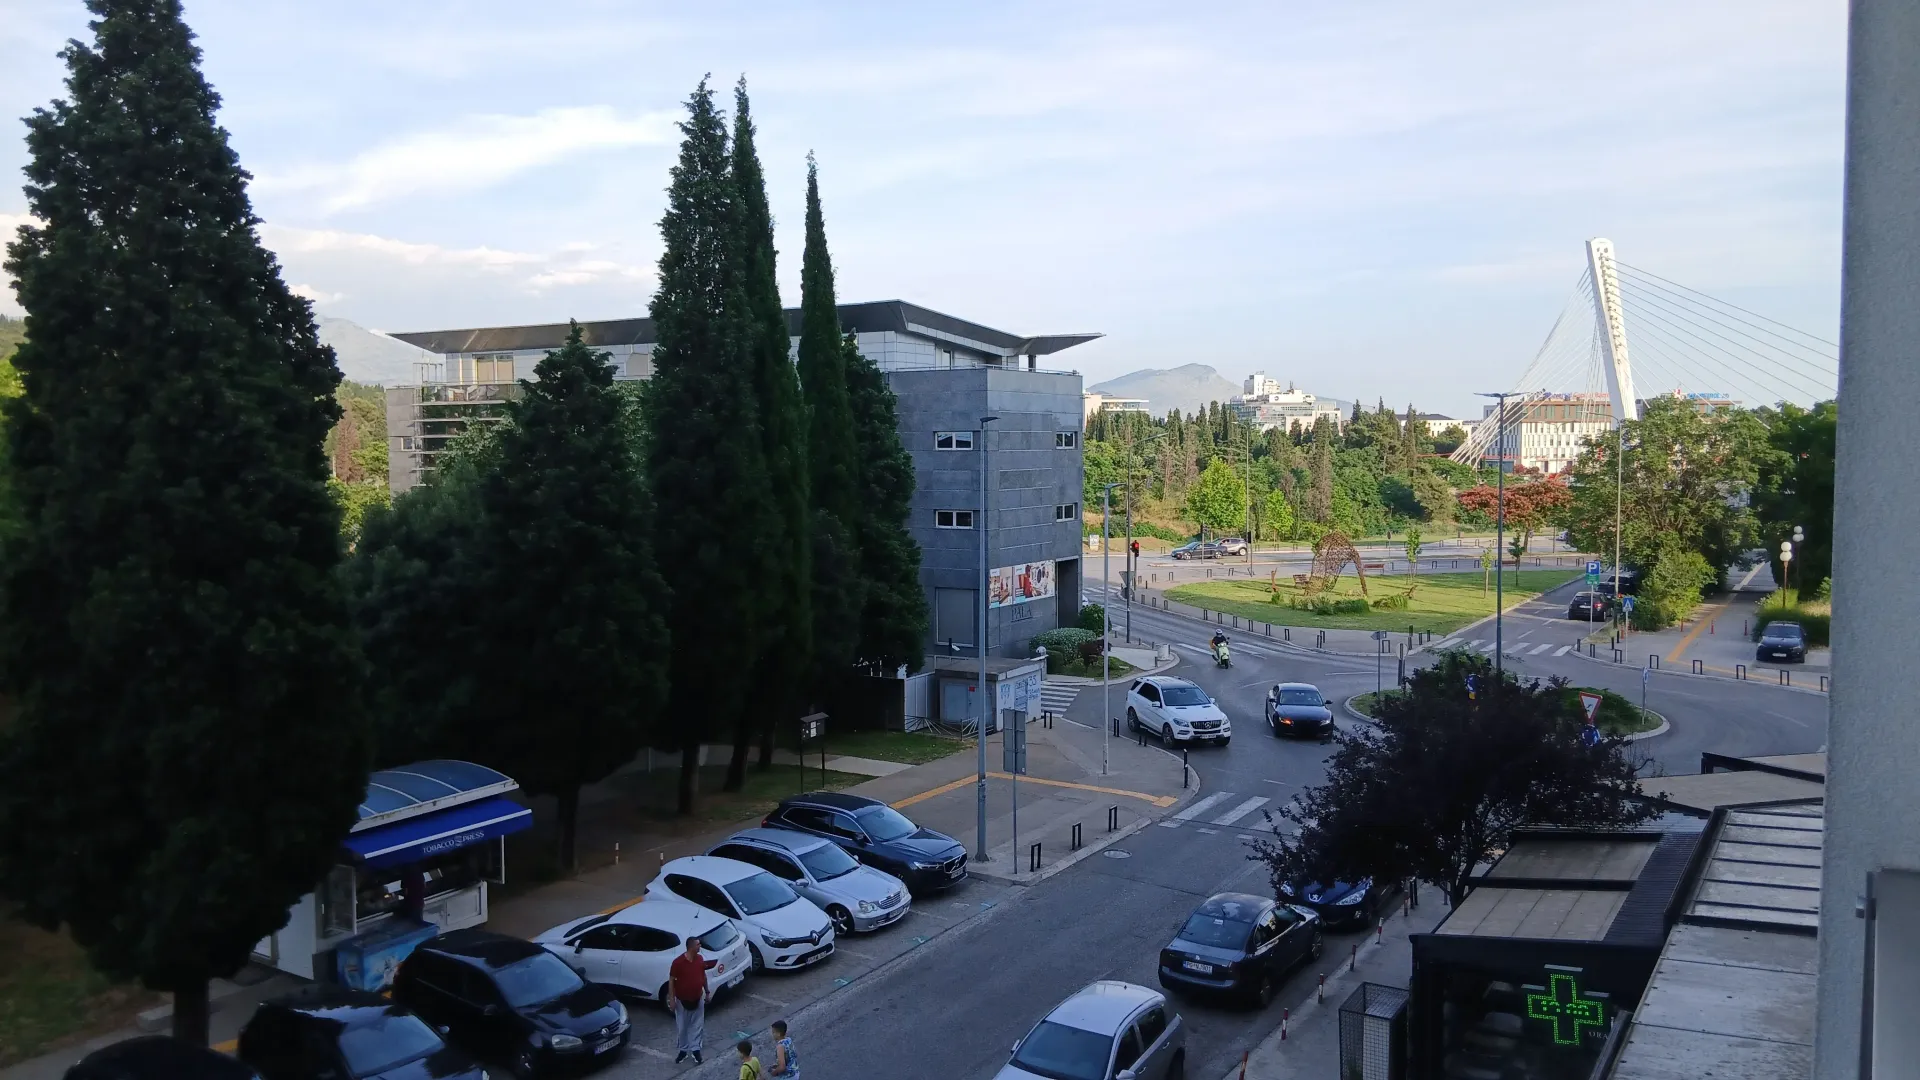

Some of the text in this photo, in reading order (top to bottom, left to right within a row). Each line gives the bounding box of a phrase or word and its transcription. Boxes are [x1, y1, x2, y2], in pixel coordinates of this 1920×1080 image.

[1588, 562, 1598, 573] P
[423, 839, 455, 853] TOBACCO
[462, 831, 485, 842] PRESS
